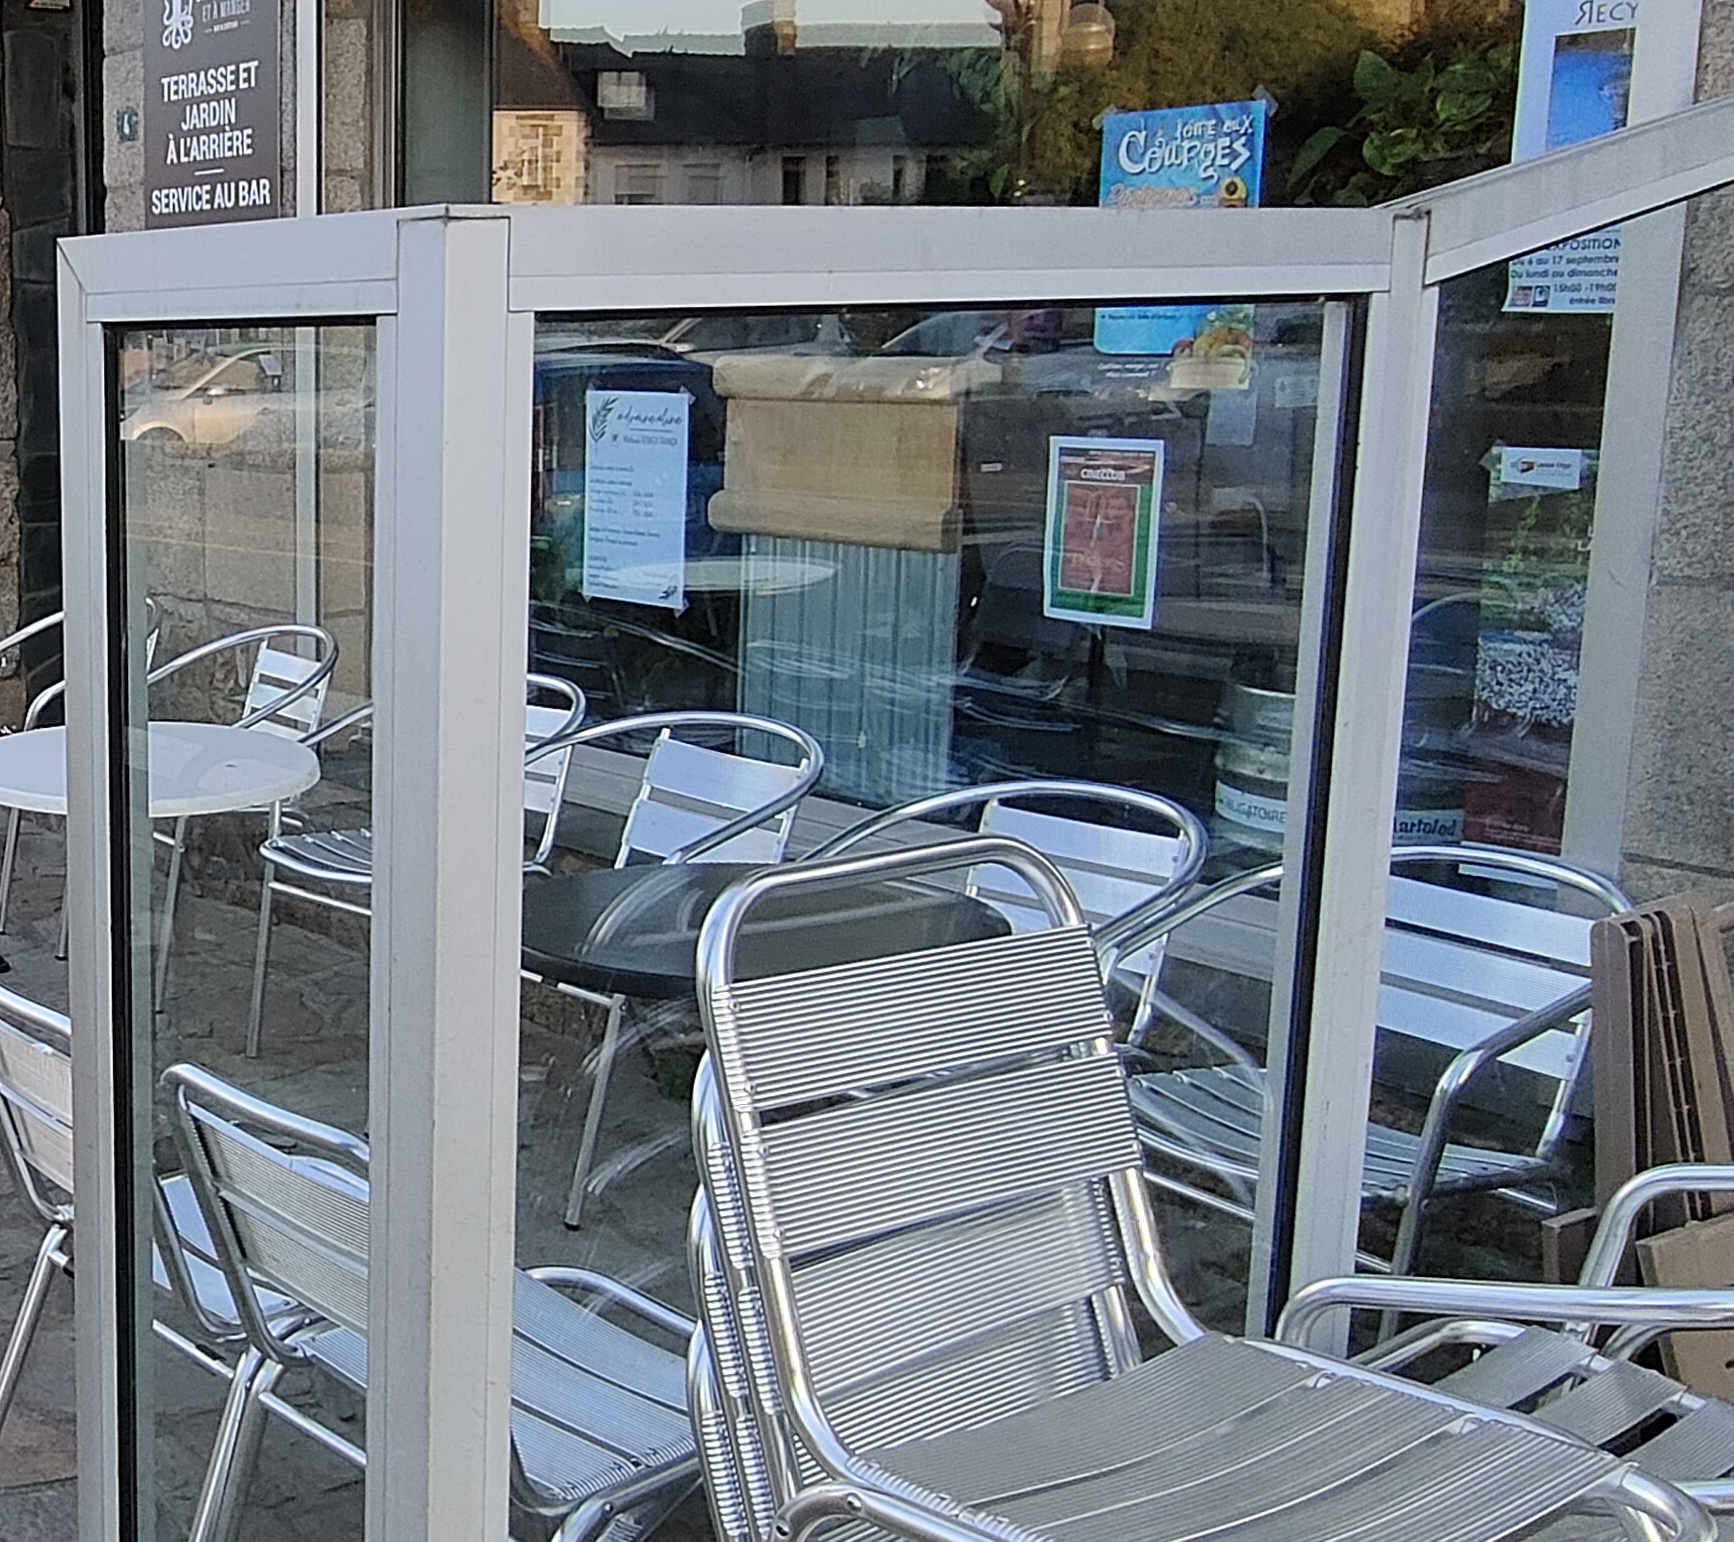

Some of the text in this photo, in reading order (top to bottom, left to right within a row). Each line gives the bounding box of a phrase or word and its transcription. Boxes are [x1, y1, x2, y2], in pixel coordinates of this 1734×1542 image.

[161, 60, 259, 102] TERRASSE ET
[181, 97, 236, 131] JARDIN
[166, 126, 253, 165] À L'ARRIÈRE
[151, 178, 271, 216] SERVICE AU BAR
